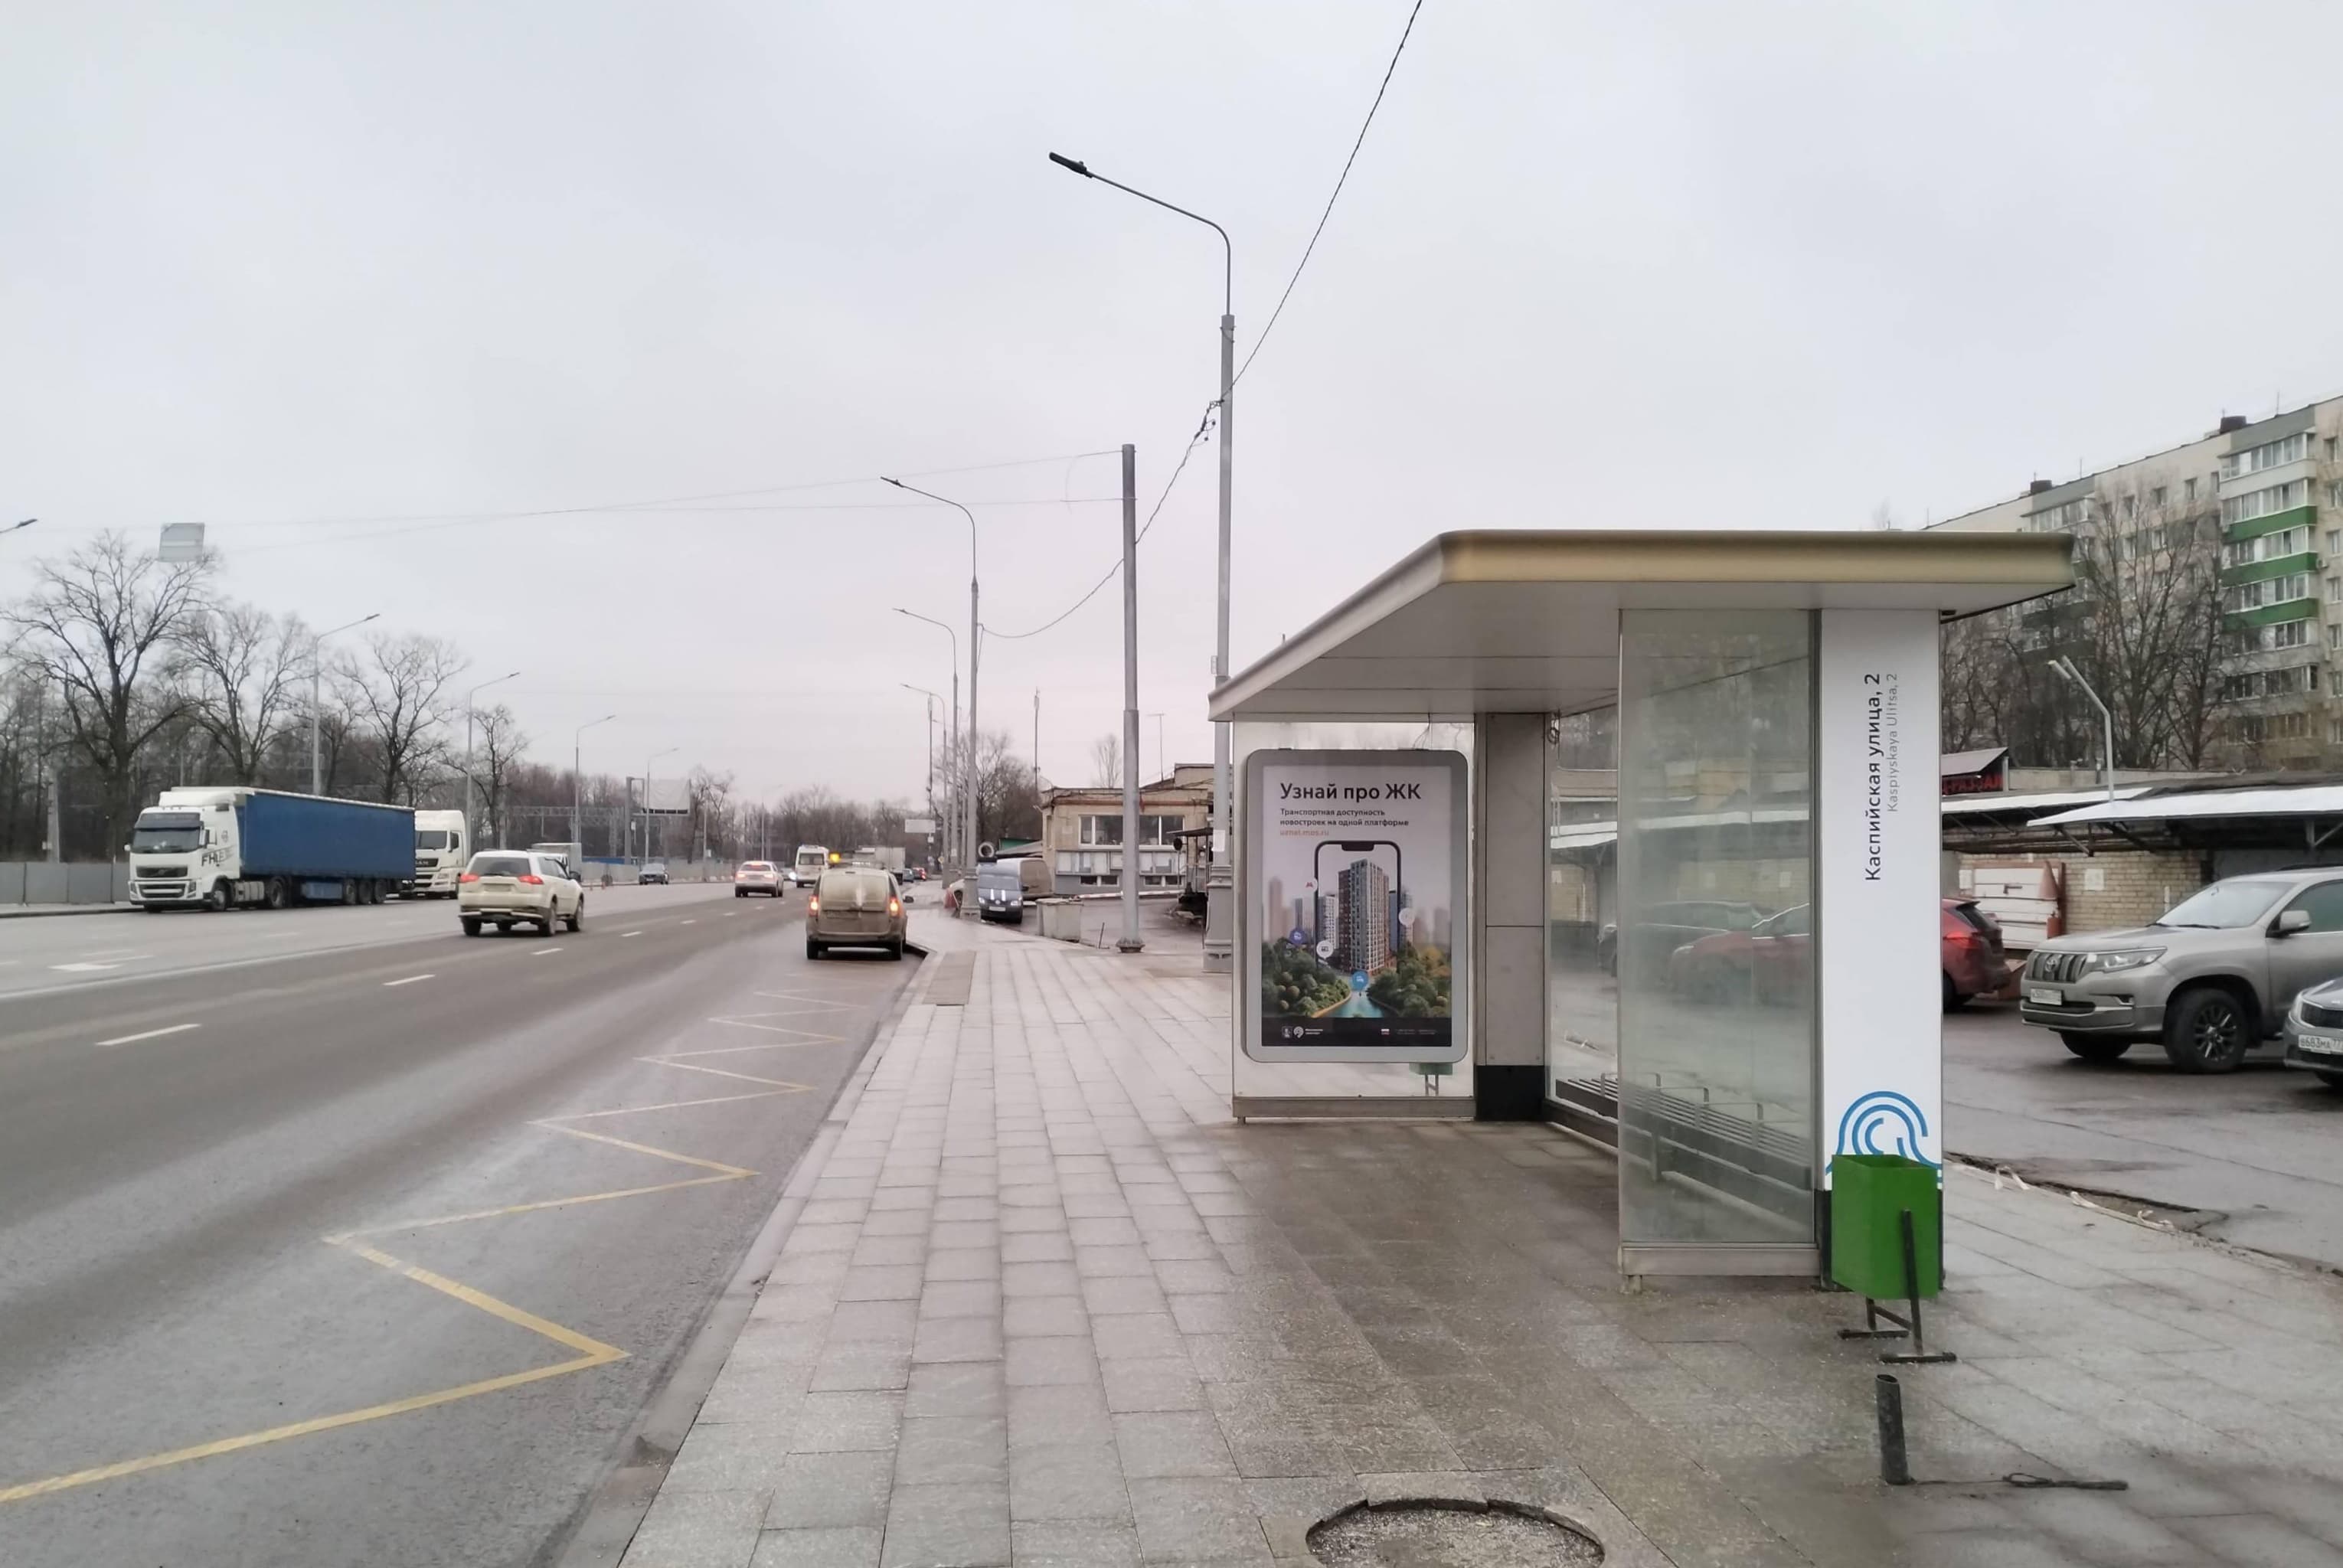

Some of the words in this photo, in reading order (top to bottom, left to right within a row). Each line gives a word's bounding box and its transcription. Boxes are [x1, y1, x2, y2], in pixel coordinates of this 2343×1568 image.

[1864, 674, 1881, 685] 2
[1886, 673, 1897, 681] 2
[1886, 684, 1899, 727] Ulitsa,
[1868, 691, 1884, 756] улица,
[1886, 730, 1900, 812] Kaspiyskaya
[1280, 782, 1337, 799] Узнай
[1344, 786, 1380, 802] про
[1385, 783, 1422, 799] ЖК
[1279, 808, 1335, 817] Транспортная
[1336, 808, 1385, 817] доступность
[1864, 763, 1881, 881] Каспийская
[1364, 818, 1410, 828] платформе
